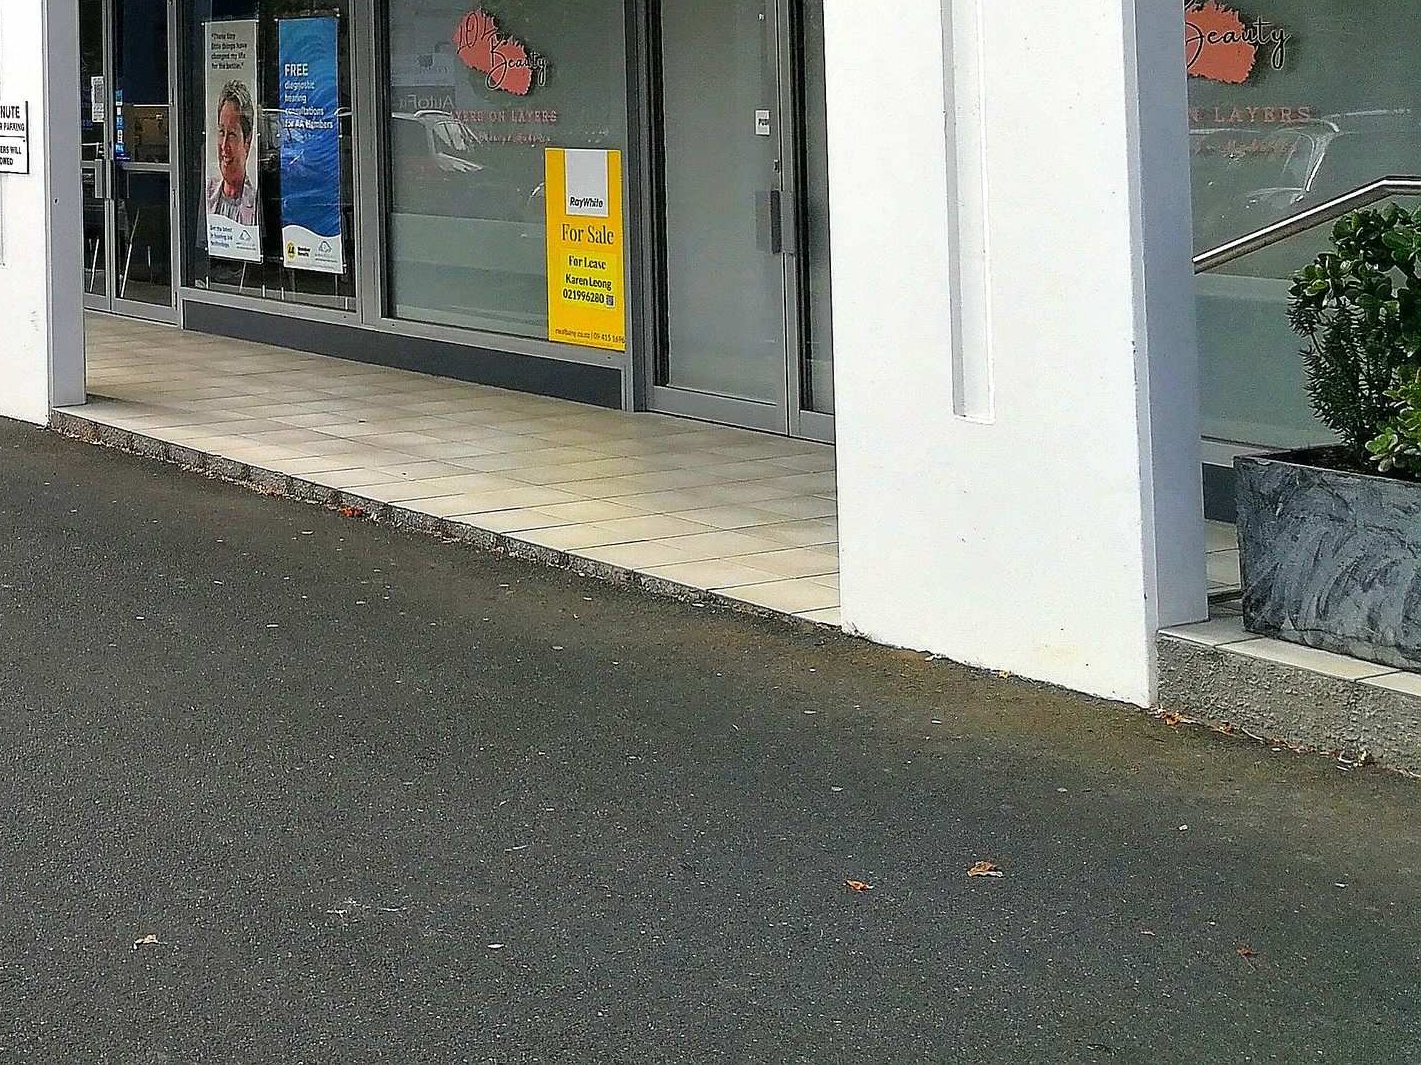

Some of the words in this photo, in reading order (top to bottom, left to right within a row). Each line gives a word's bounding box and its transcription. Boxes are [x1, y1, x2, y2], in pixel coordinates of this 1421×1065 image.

[486, 32, 546, 90] Beauty
[284, 63, 309, 76] FREE
[284, 80, 315, 91] diagnostic
[284, 94, 307, 104] hearing
[488, 111, 506, 122] ON
[511, 110, 558, 123] LAYERS
[1213, 106, 1312, 123] LAYERS
[3, 122, 25, 132] PARKING
[10, 146, 22, 155] WILL
[562, 223, 584, 242] For
[587, 225, 614, 245] Sale
[568, 255, 583, 267] For
[584, 256, 607, 269] Lease
[565, 273, 588, 286] Karen
[589, 276, 612, 291] Leong
[562, 288, 605, 304] 021996280
